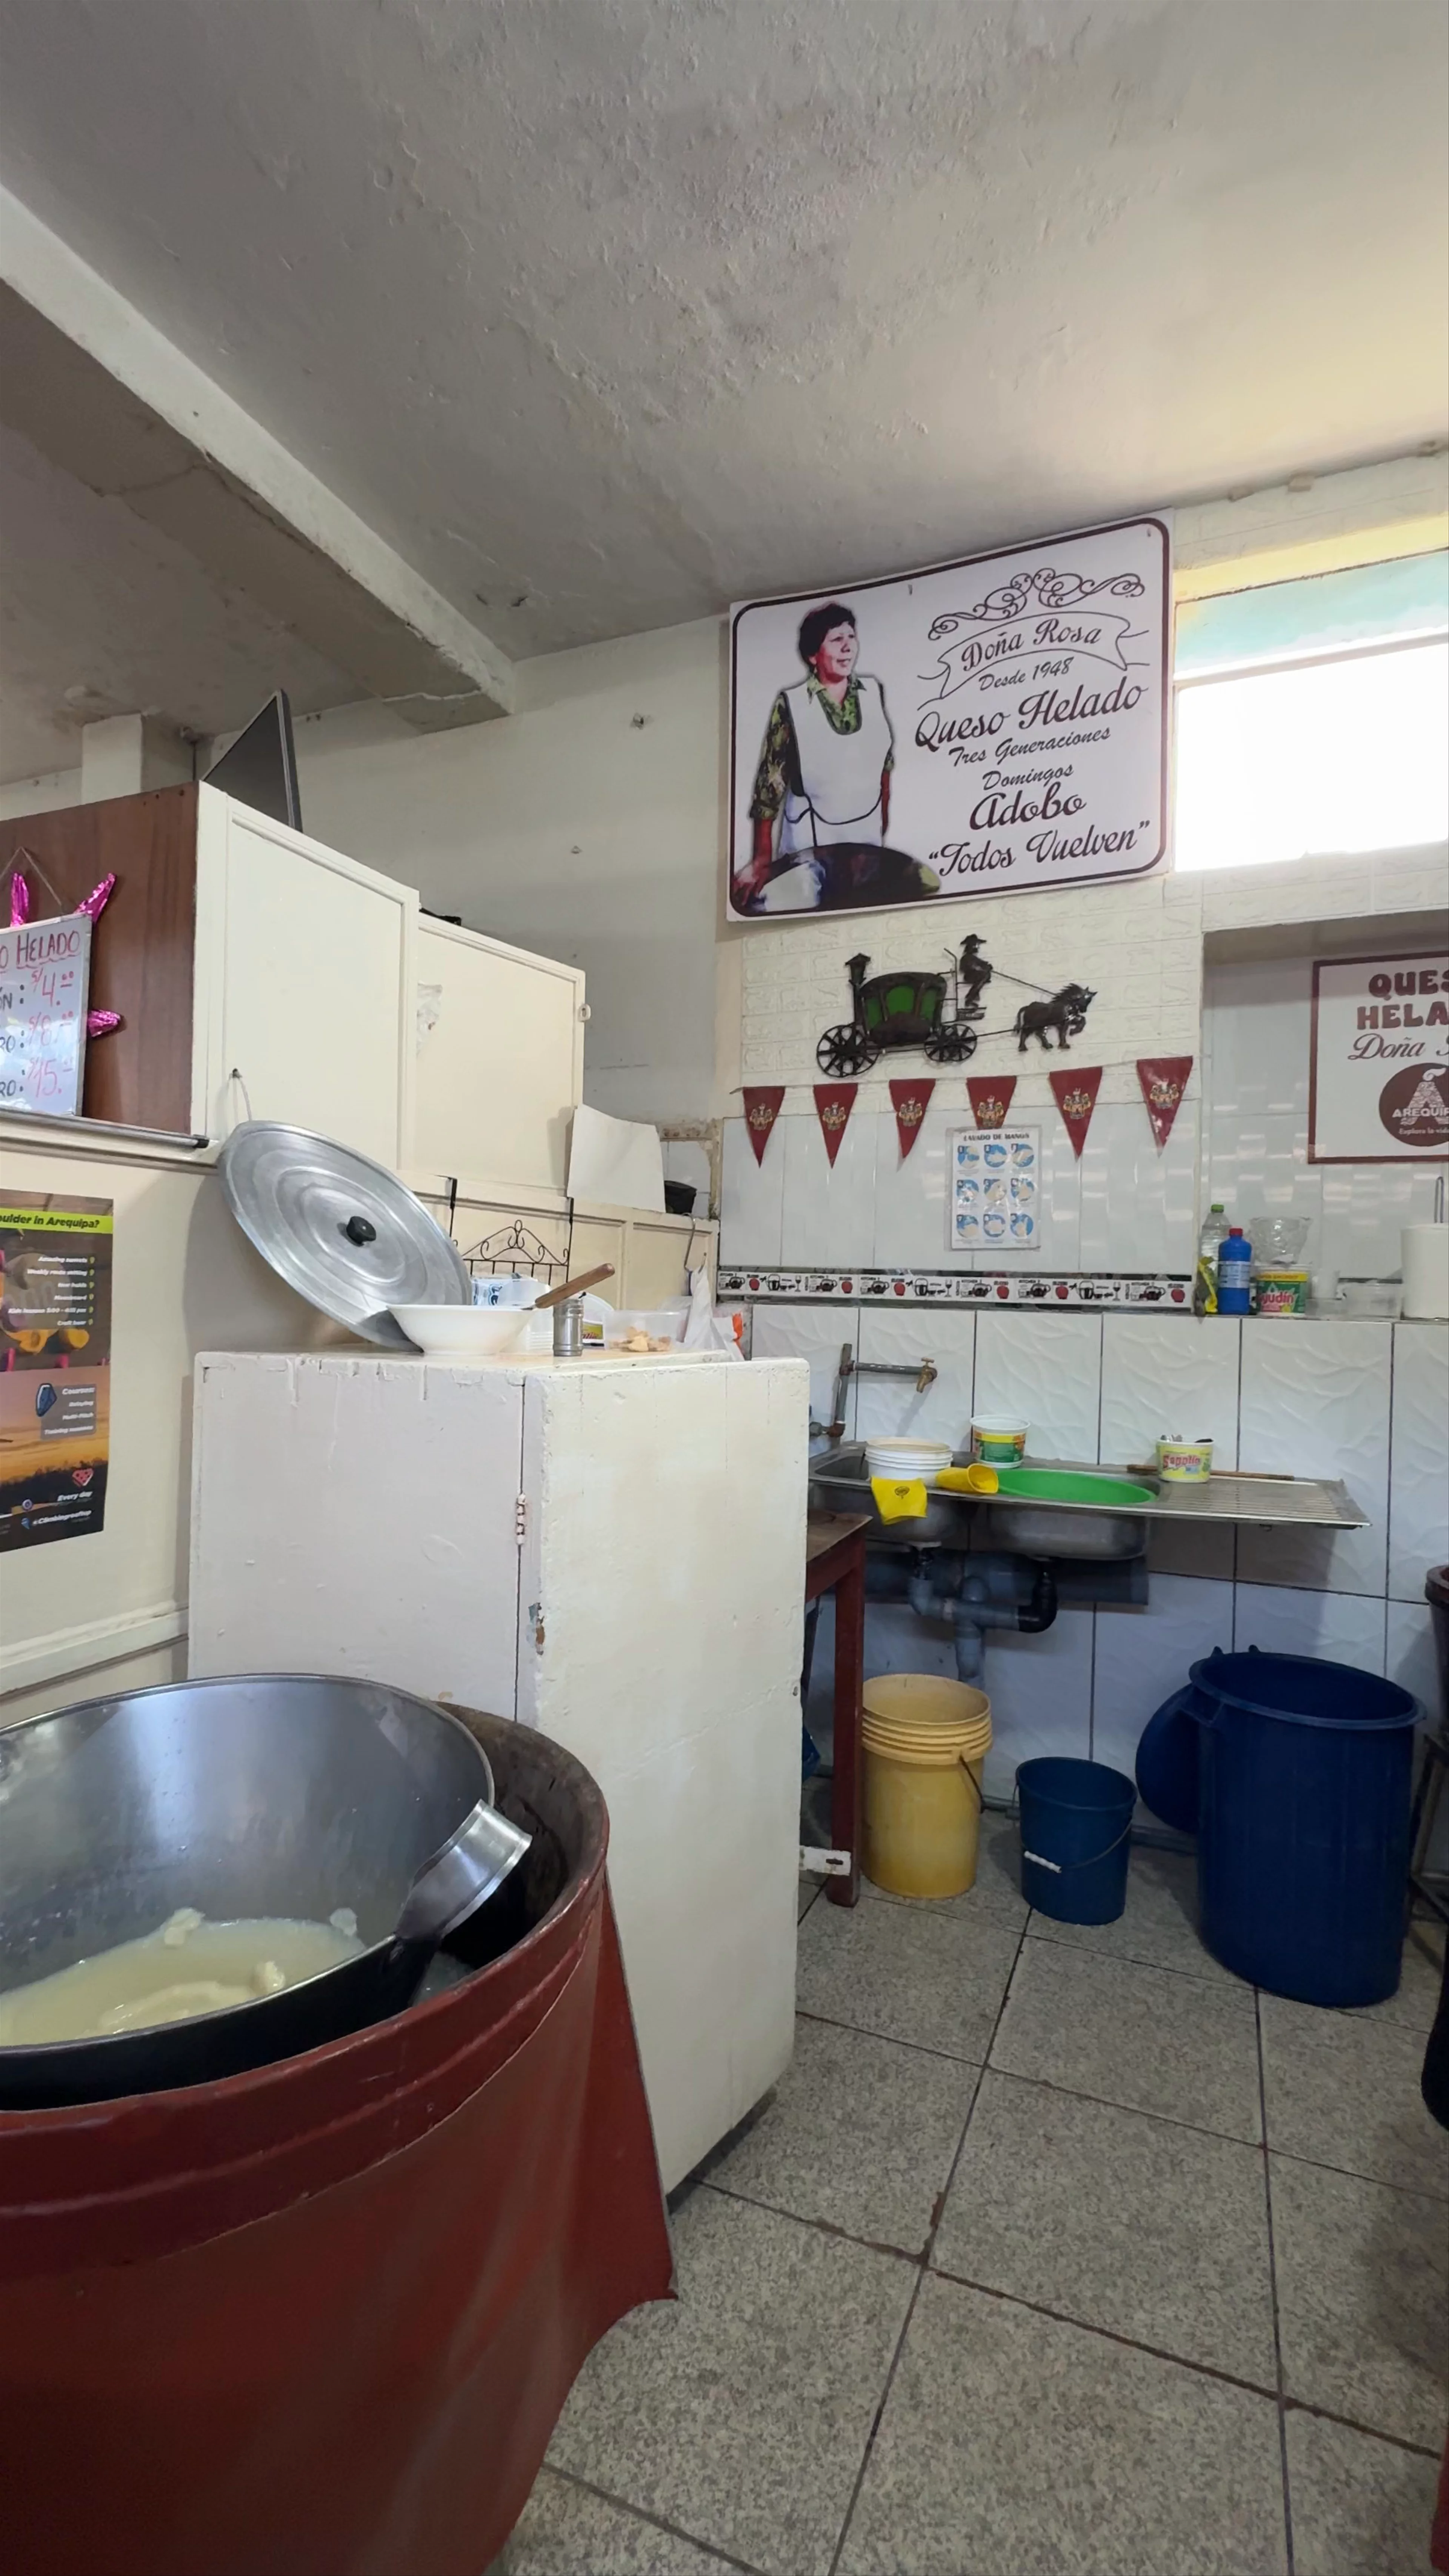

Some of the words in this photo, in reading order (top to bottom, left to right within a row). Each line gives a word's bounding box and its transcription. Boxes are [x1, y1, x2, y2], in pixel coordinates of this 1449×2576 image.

[961, 633, 1024, 671] Doña
[1033, 618, 1101, 645] Rosa
[979, 671, 1026, 691] Desde
[1032, 657, 1074, 680] 1948
[915, 711, 1011, 753] Queso
[1018, 676, 1149, 730] Helado
[949, 746, 986, 767] Tres
[995, 727, 1111, 766] Generaciones
[982, 764, 1074, 790] Domingos
[969, 781, 1088, 830] Adobo
[17, 930, 80, 964] HELADO
[1348, 1033, 1426, 1060] Doña
[34, 1215, 44, 1225] in
[46, 1217, 100, 1229] Arequipa?
[57, 1493, 79, 1502] Every
